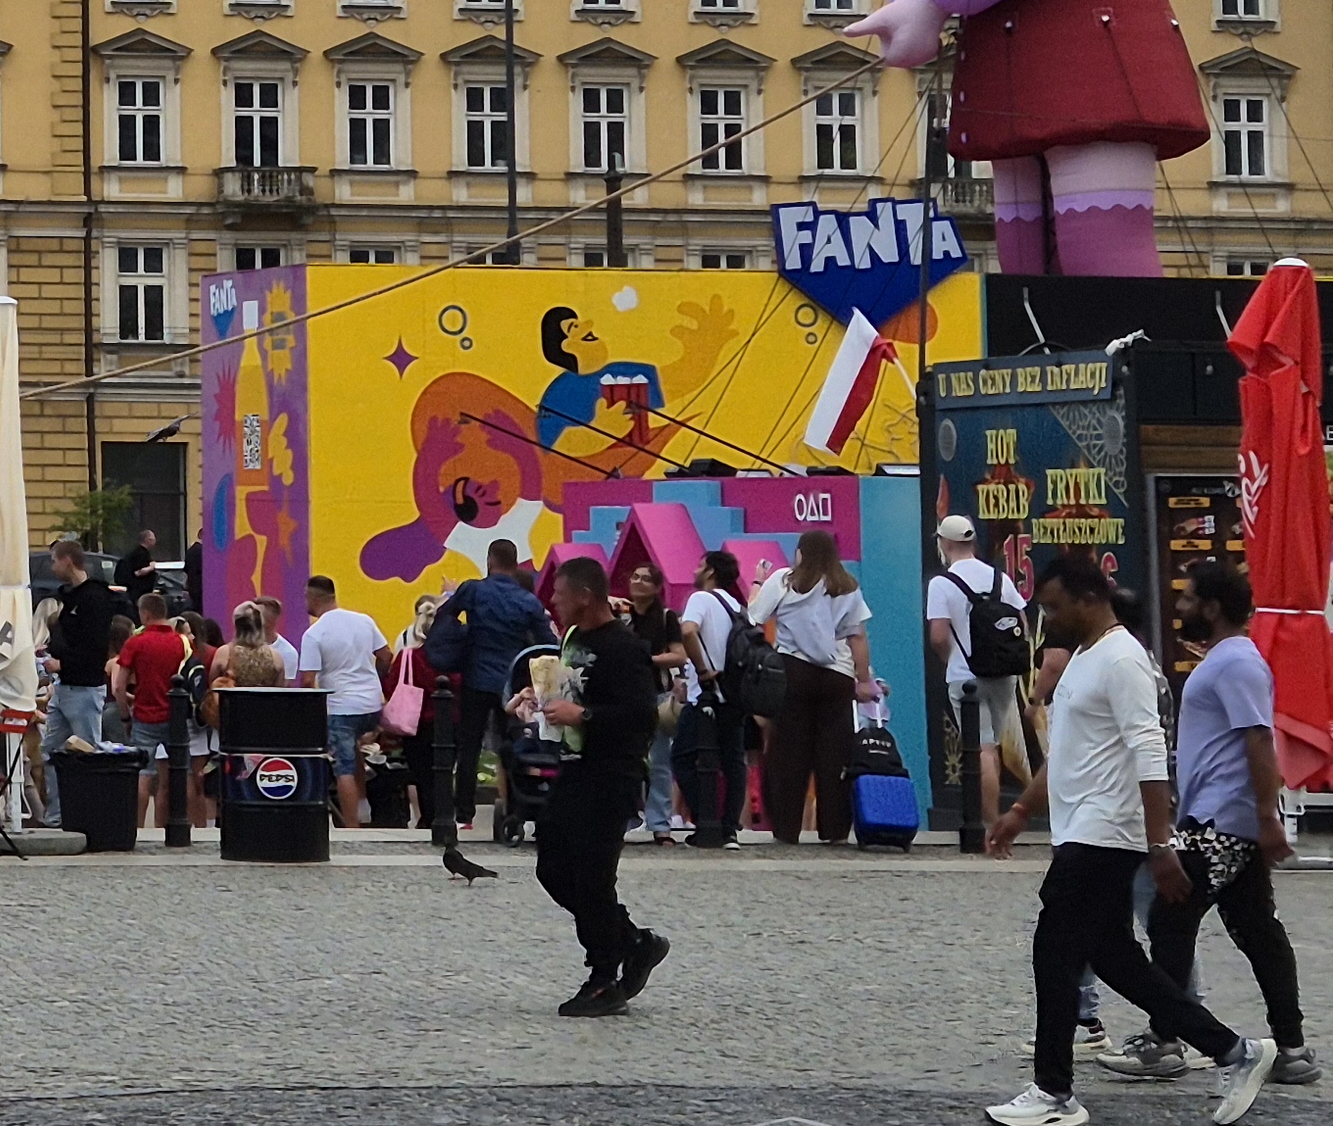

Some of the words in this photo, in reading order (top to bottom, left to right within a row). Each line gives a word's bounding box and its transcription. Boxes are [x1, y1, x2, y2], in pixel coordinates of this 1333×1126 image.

[778, 201, 963, 273] FANTA
[209, 279, 237, 317] FANTA
[938, 374, 948, 398] U
[951, 371, 975, 397] NAS
[979, 368, 1013, 395] CENY
[1016, 366, 1042, 392] BEZ
[1046, 362, 1108, 396] INFLACJI
[985, 428, 1018, 465] HOT
[976, 483, 1030, 520] KEBAB
[1045, 467, 1108, 506] FRYTKI
[1002, 532, 1034, 603] 15
